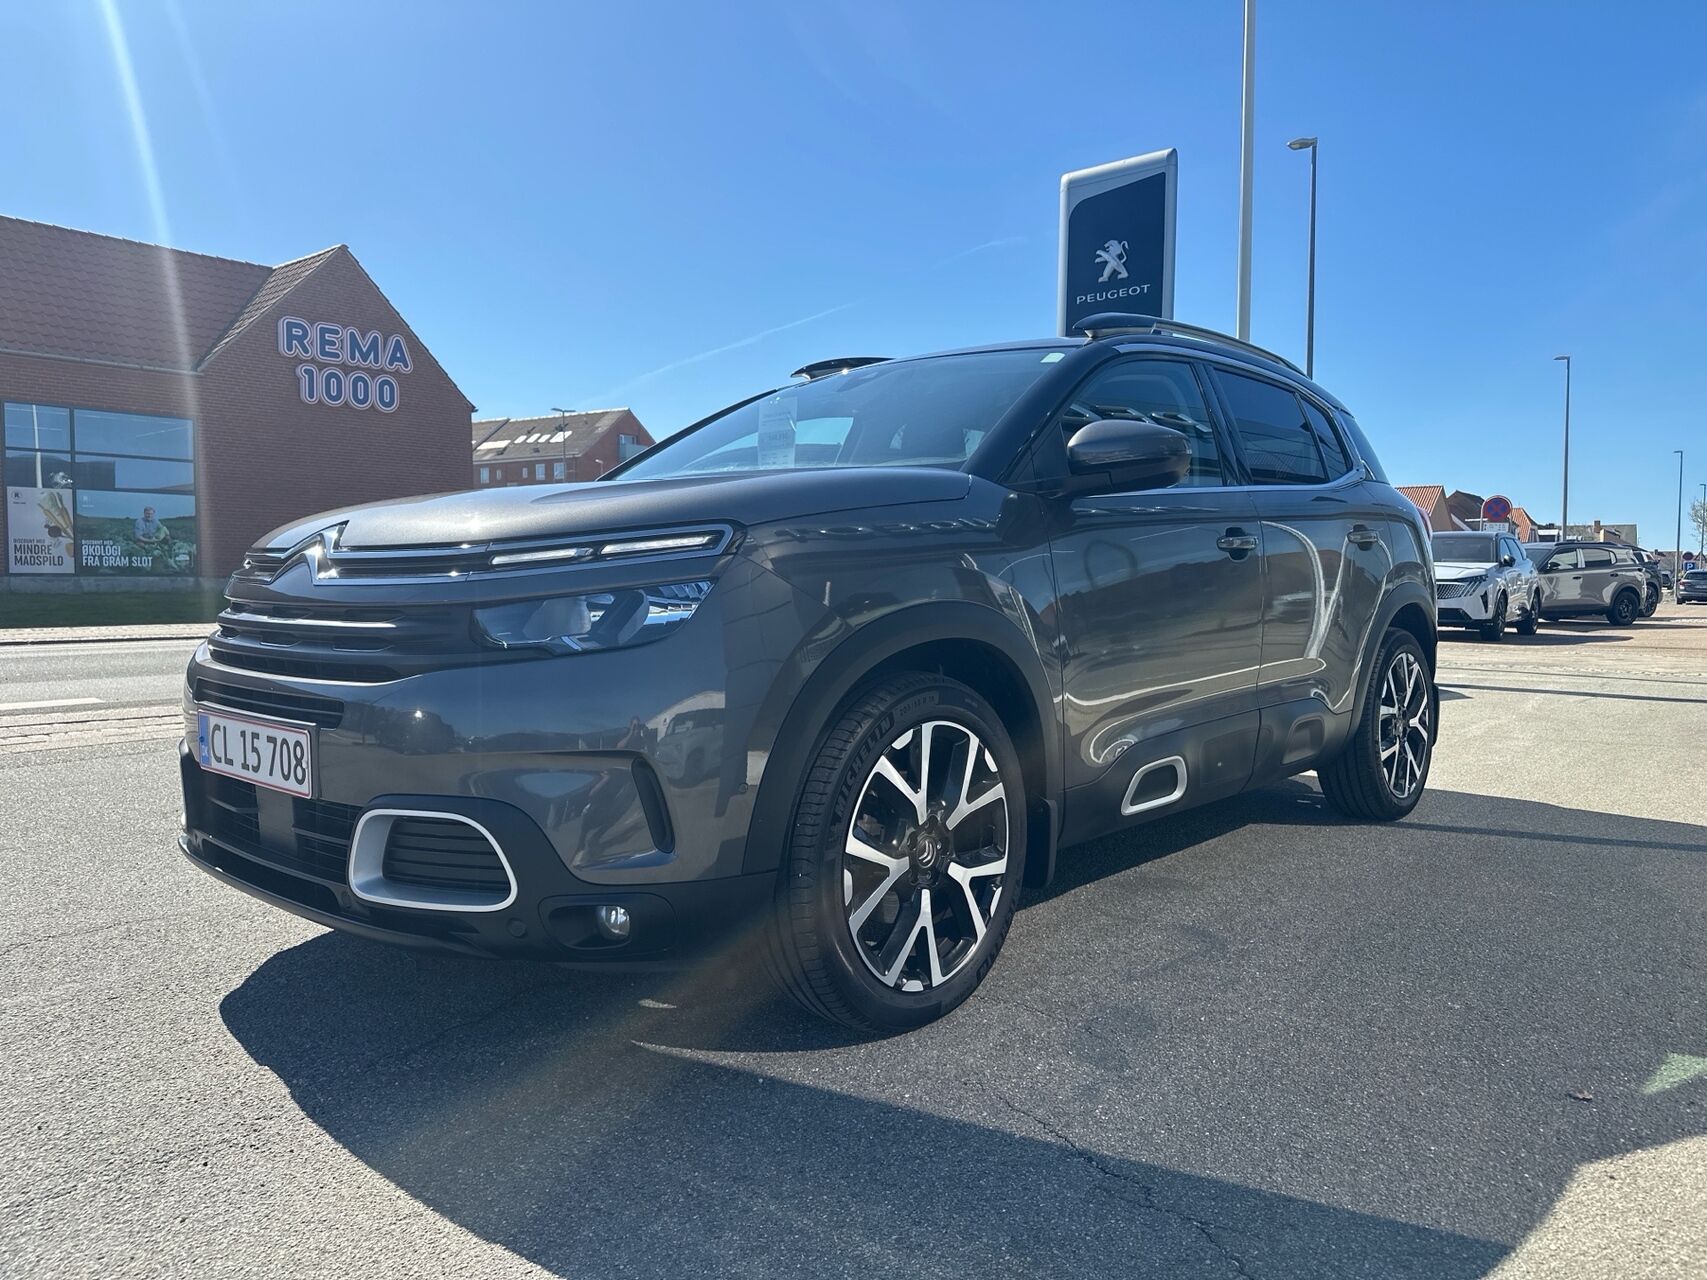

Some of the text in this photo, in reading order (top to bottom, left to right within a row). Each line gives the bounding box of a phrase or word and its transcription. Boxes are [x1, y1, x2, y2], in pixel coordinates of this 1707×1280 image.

[1076, 284, 1151, 305] PEUGEOT
[278, 315, 414, 374] REMA
[296, 363, 400, 413] 1000
[13, 543, 53, 555] MINDRE
[81, 545, 121, 557] ØKOLOGI
[14, 555, 65, 567] MADSPILD
[82, 556, 153, 568] FRA GRAM SLOT
[211, 723, 307, 786] CL 15 708
